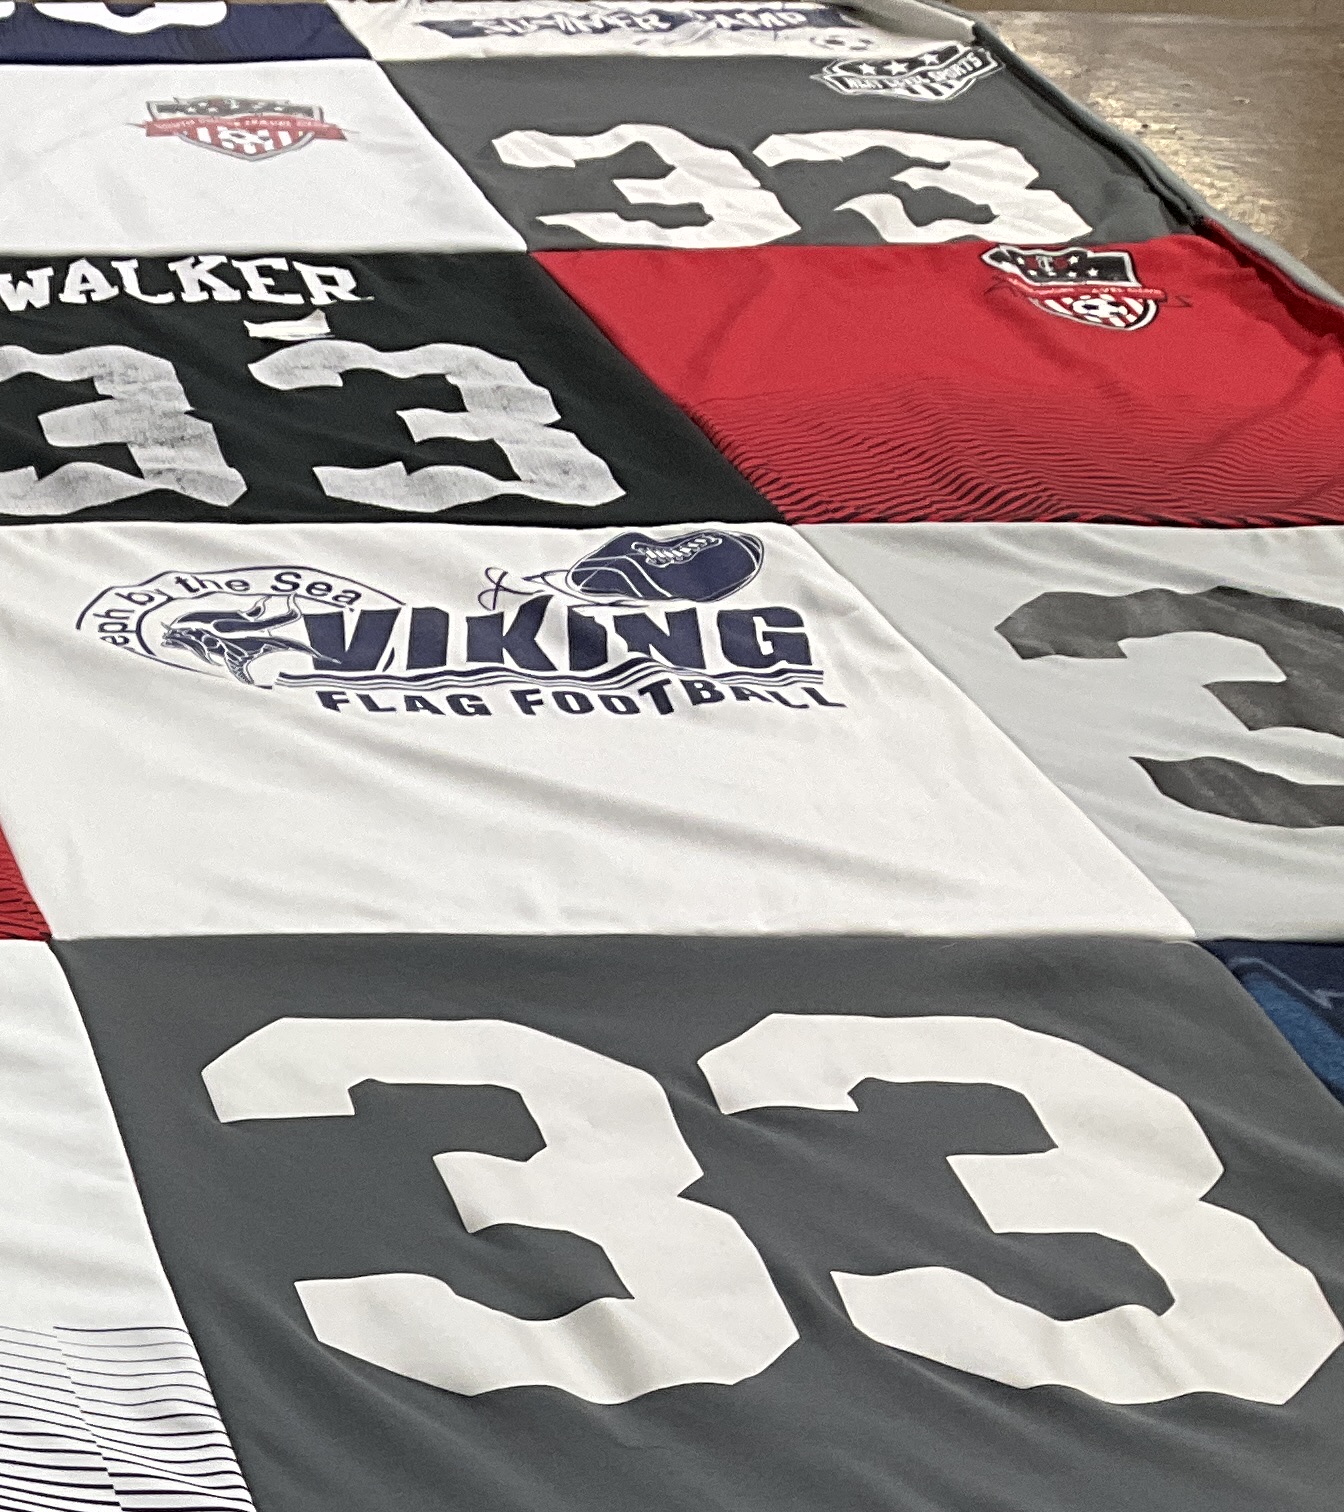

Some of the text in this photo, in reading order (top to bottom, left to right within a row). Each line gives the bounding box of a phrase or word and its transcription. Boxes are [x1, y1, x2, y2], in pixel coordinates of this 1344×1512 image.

[491, 123, 1094, 249] 33
[174, 575, 251, 594] the
[270, 571, 362, 606] Sea
[302, 595, 814, 671] VIKING
[314, 678, 848, 717] FLAG FOOTBALL
[200, 1012, 1344, 1405] 33
